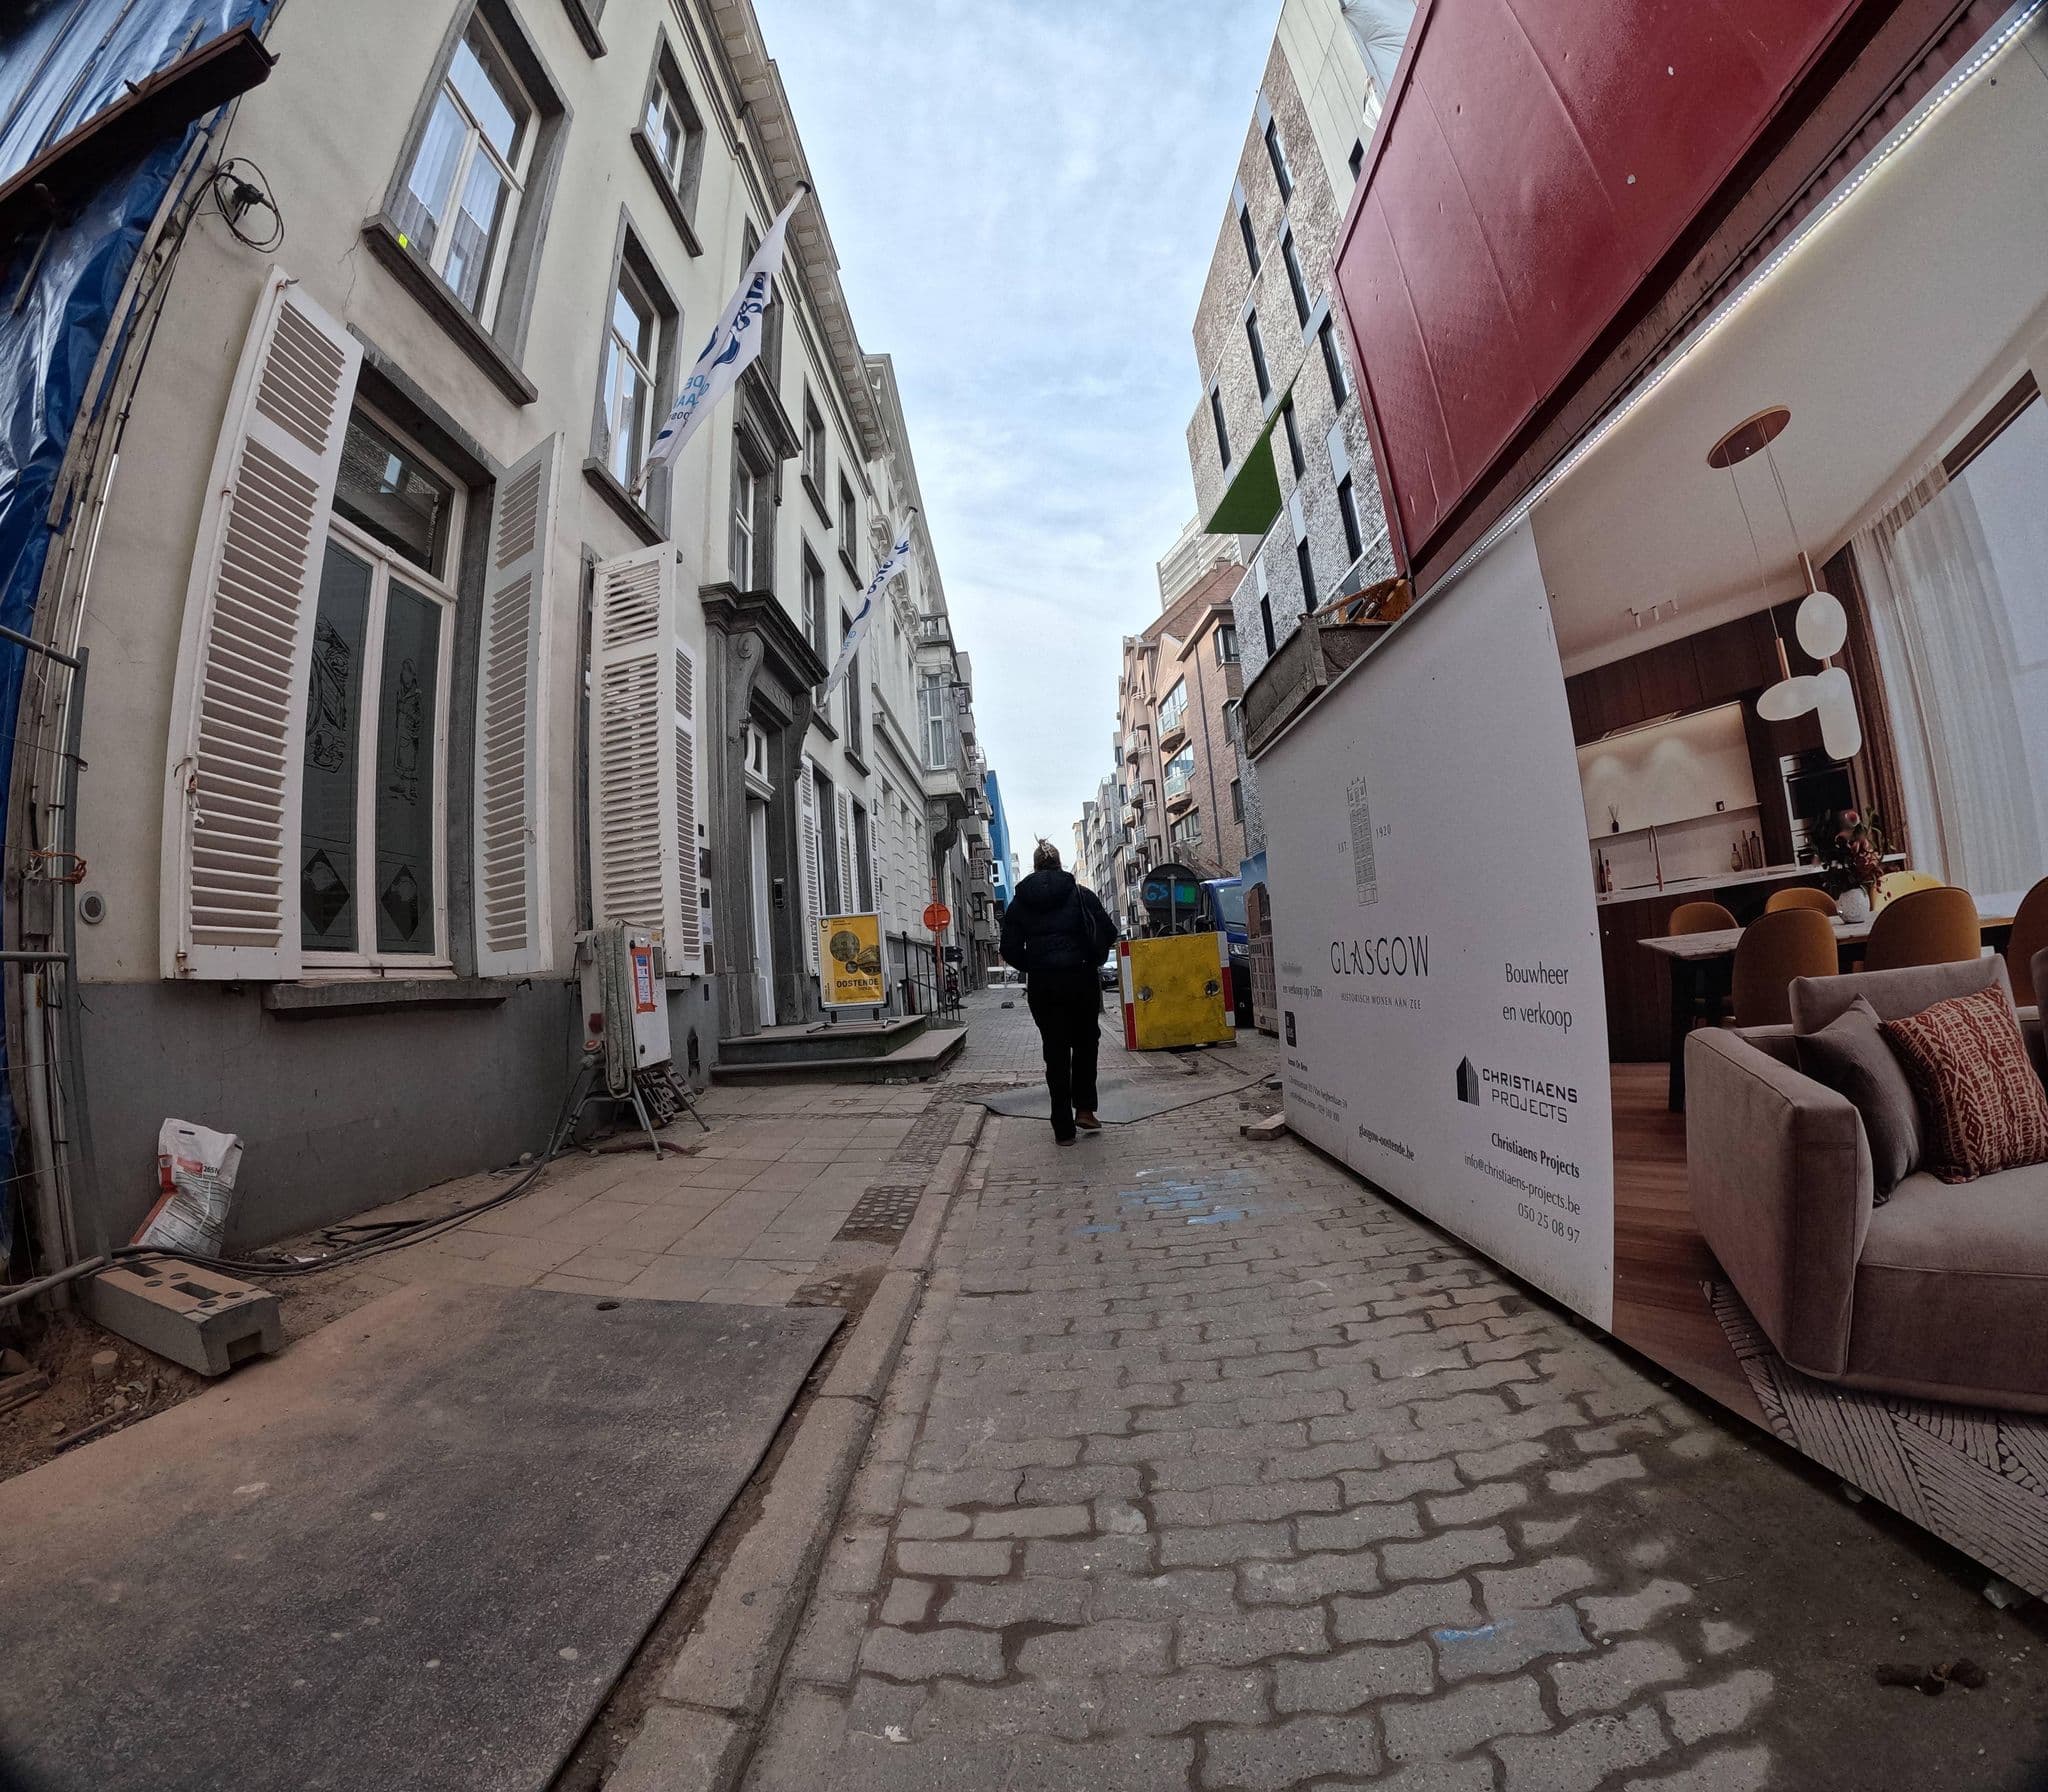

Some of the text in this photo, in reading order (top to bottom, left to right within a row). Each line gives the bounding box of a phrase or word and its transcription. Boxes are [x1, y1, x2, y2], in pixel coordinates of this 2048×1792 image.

[1330, 935, 1428, 976] GLASGOW
[836, 978, 879, 988] OOSTENDE
[1505, 961, 1568, 985] Bouwheer
[1394, 998, 1407, 1008] AAN
[1409, 999, 1422, 1010] ZEE
[1502, 1001, 1573, 1034] en verkoop
[1482, 1068, 1578, 1103] CHRISTIAENS
[1491, 1089, 1568, 1123] PROJECTS
[1491, 1132, 1580, 1179] Christiaens Projects
[1464, 1152, 1581, 1216] info@christiaens-projects.be
[1518, 1203, 1580, 1244] 050 25 08 97
